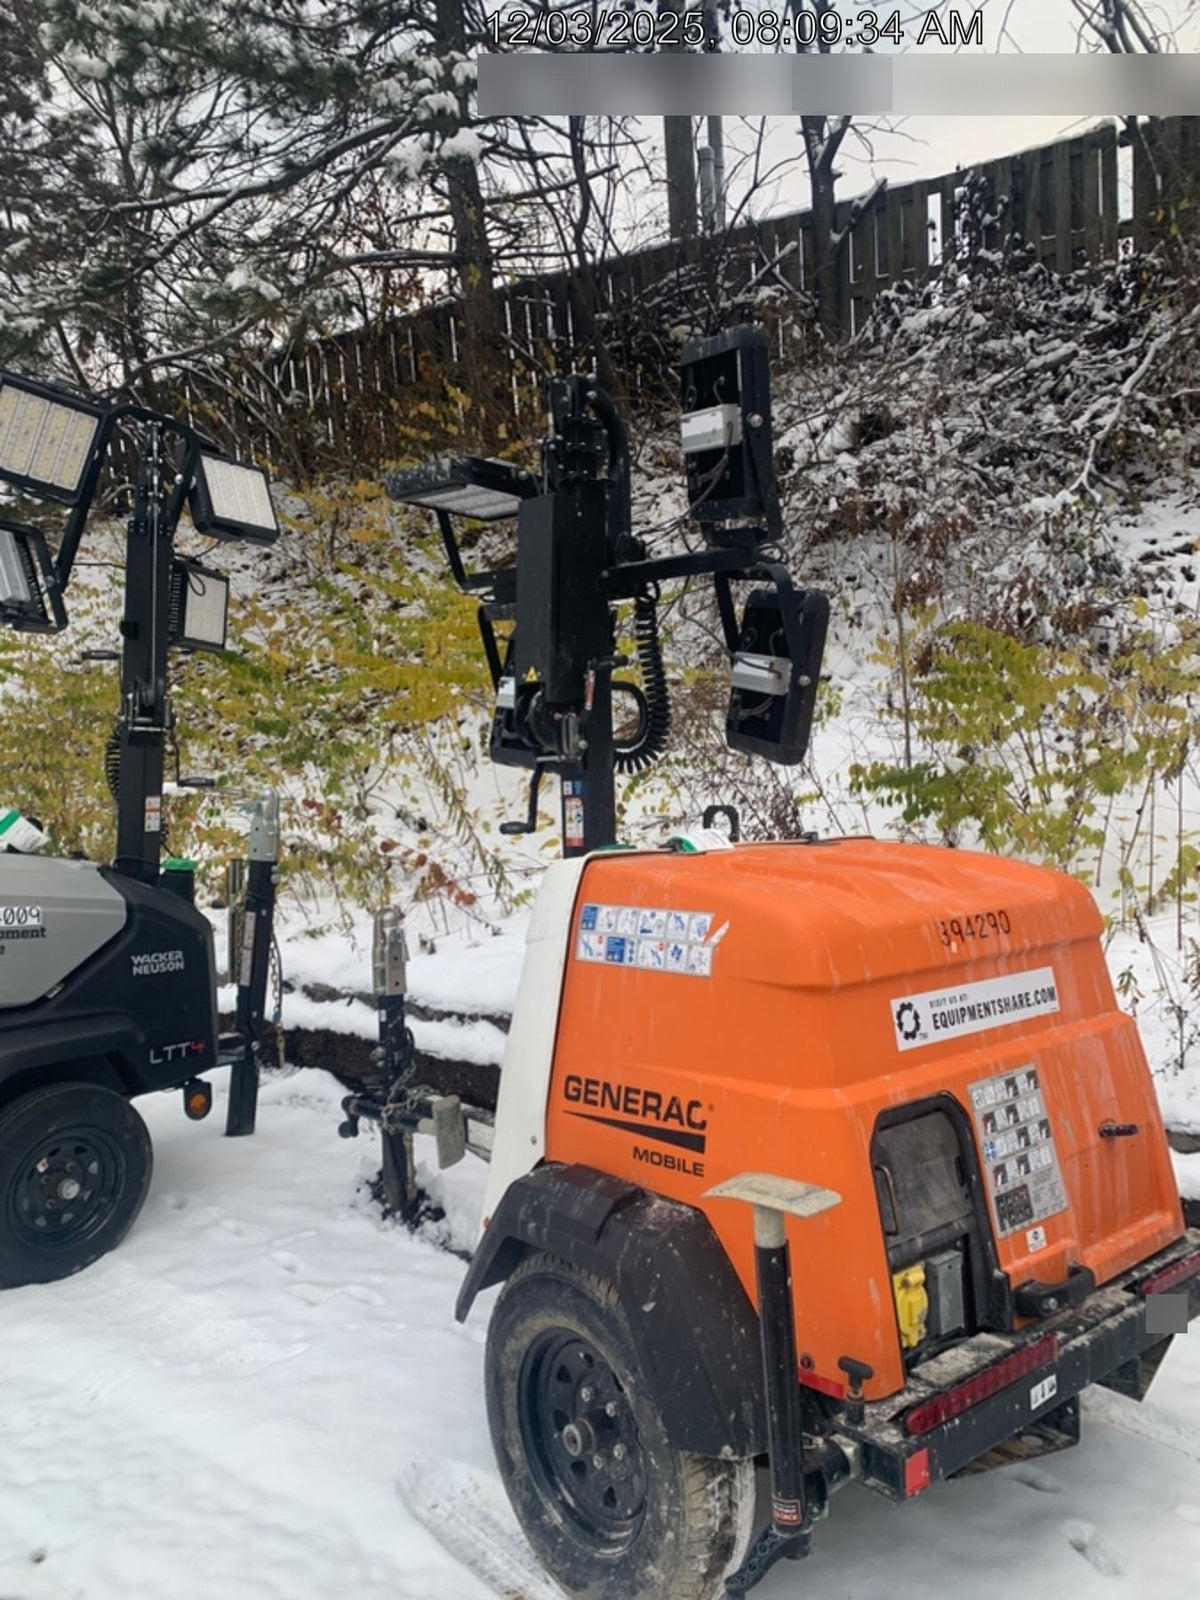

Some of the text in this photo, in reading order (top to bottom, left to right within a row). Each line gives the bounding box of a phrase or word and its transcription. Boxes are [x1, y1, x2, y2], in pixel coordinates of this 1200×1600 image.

[131, 951, 183, 965] WACKER
[133, 961, 184, 976] NEUSON
[932, 986, 1057, 1030] EQUIPMENTSHARE.COM
[564, 1075, 707, 1130] GENERAC
